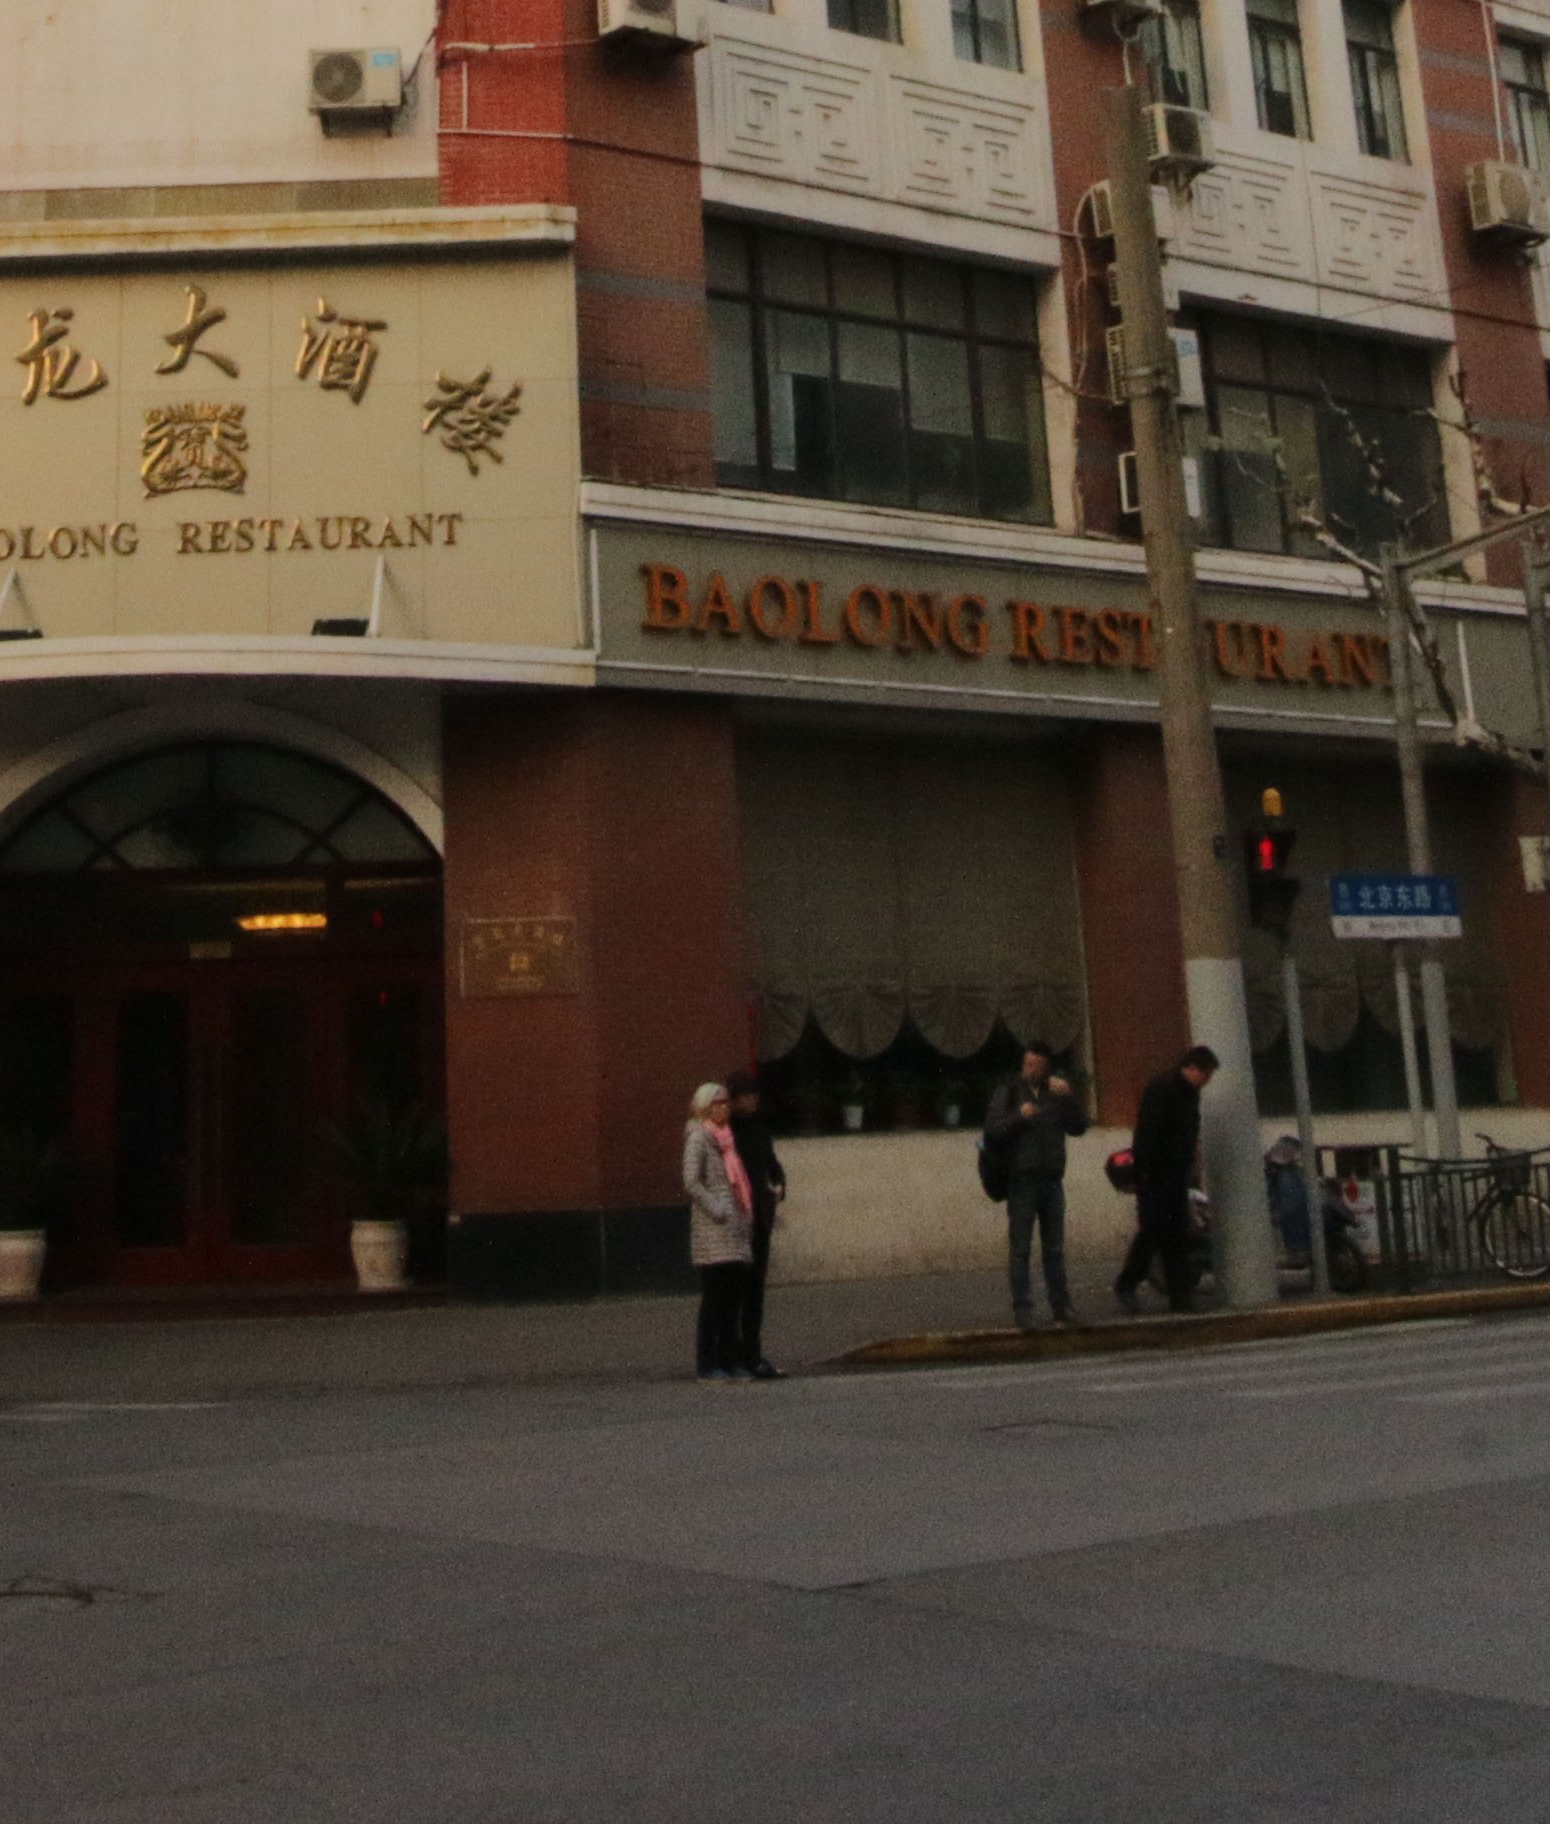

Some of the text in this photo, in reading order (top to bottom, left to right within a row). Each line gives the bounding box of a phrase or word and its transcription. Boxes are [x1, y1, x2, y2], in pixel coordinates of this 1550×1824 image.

[177, 512, 465, 556] RESTAURANT
[640, 562, 1394, 688] BAOLONG RESTURAN
[1358, 882, 1433, 911] 北京东路
